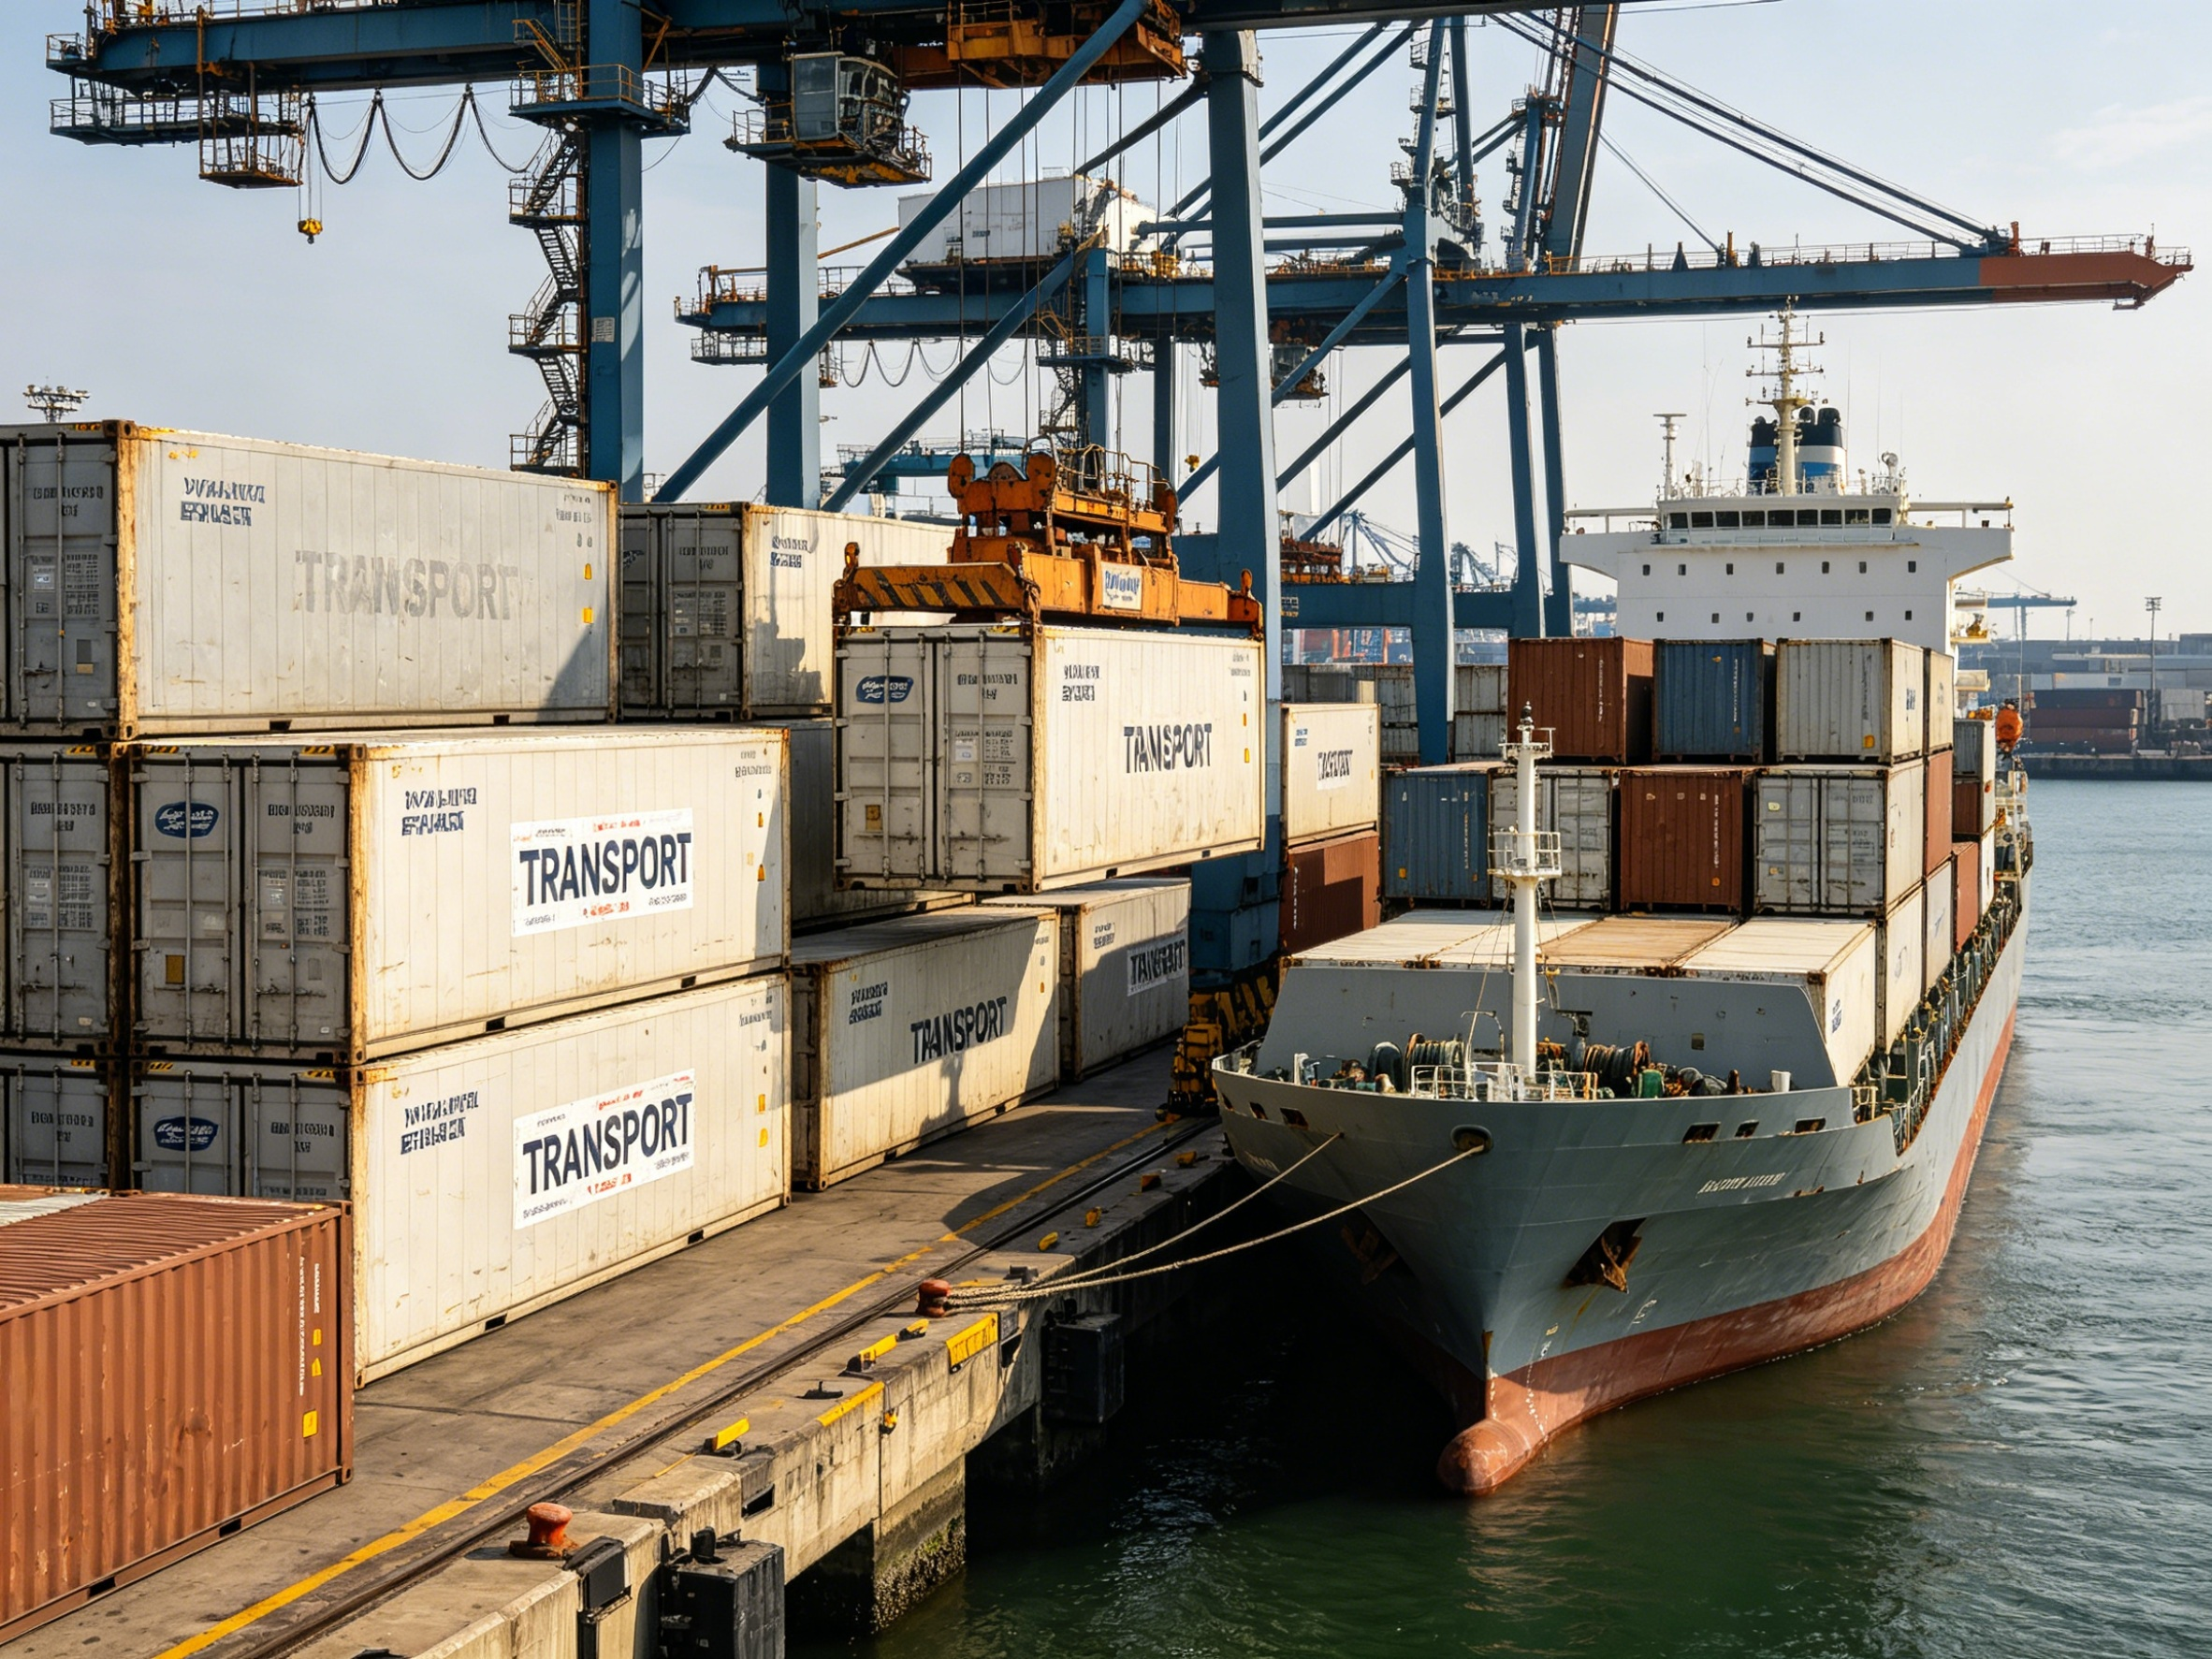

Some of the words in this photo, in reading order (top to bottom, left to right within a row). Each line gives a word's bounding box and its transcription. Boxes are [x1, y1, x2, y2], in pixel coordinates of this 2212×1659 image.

[295, 550, 519, 620] TRANSPORT
[518, 833, 691, 907] TRANSPORT
[522, 1093, 693, 1195] TRANSPORT
